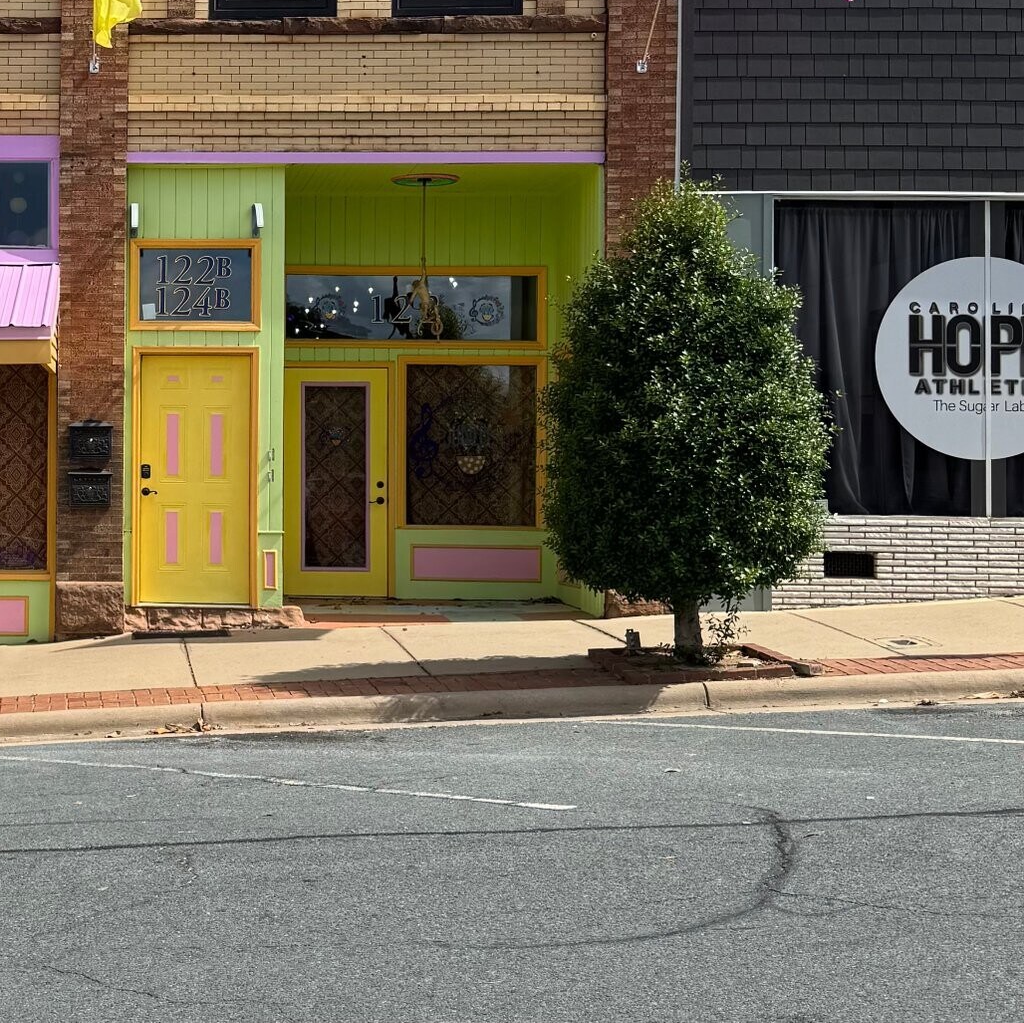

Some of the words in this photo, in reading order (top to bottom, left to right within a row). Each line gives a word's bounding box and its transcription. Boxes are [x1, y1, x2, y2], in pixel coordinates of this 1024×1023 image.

[156, 254, 232, 286] 122B
[156, 286, 231, 317] 124B
[909, 302, 1024, 315] CAROLI
[933, 399, 956, 412] The
[959, 399, 1000, 415] Sugar
